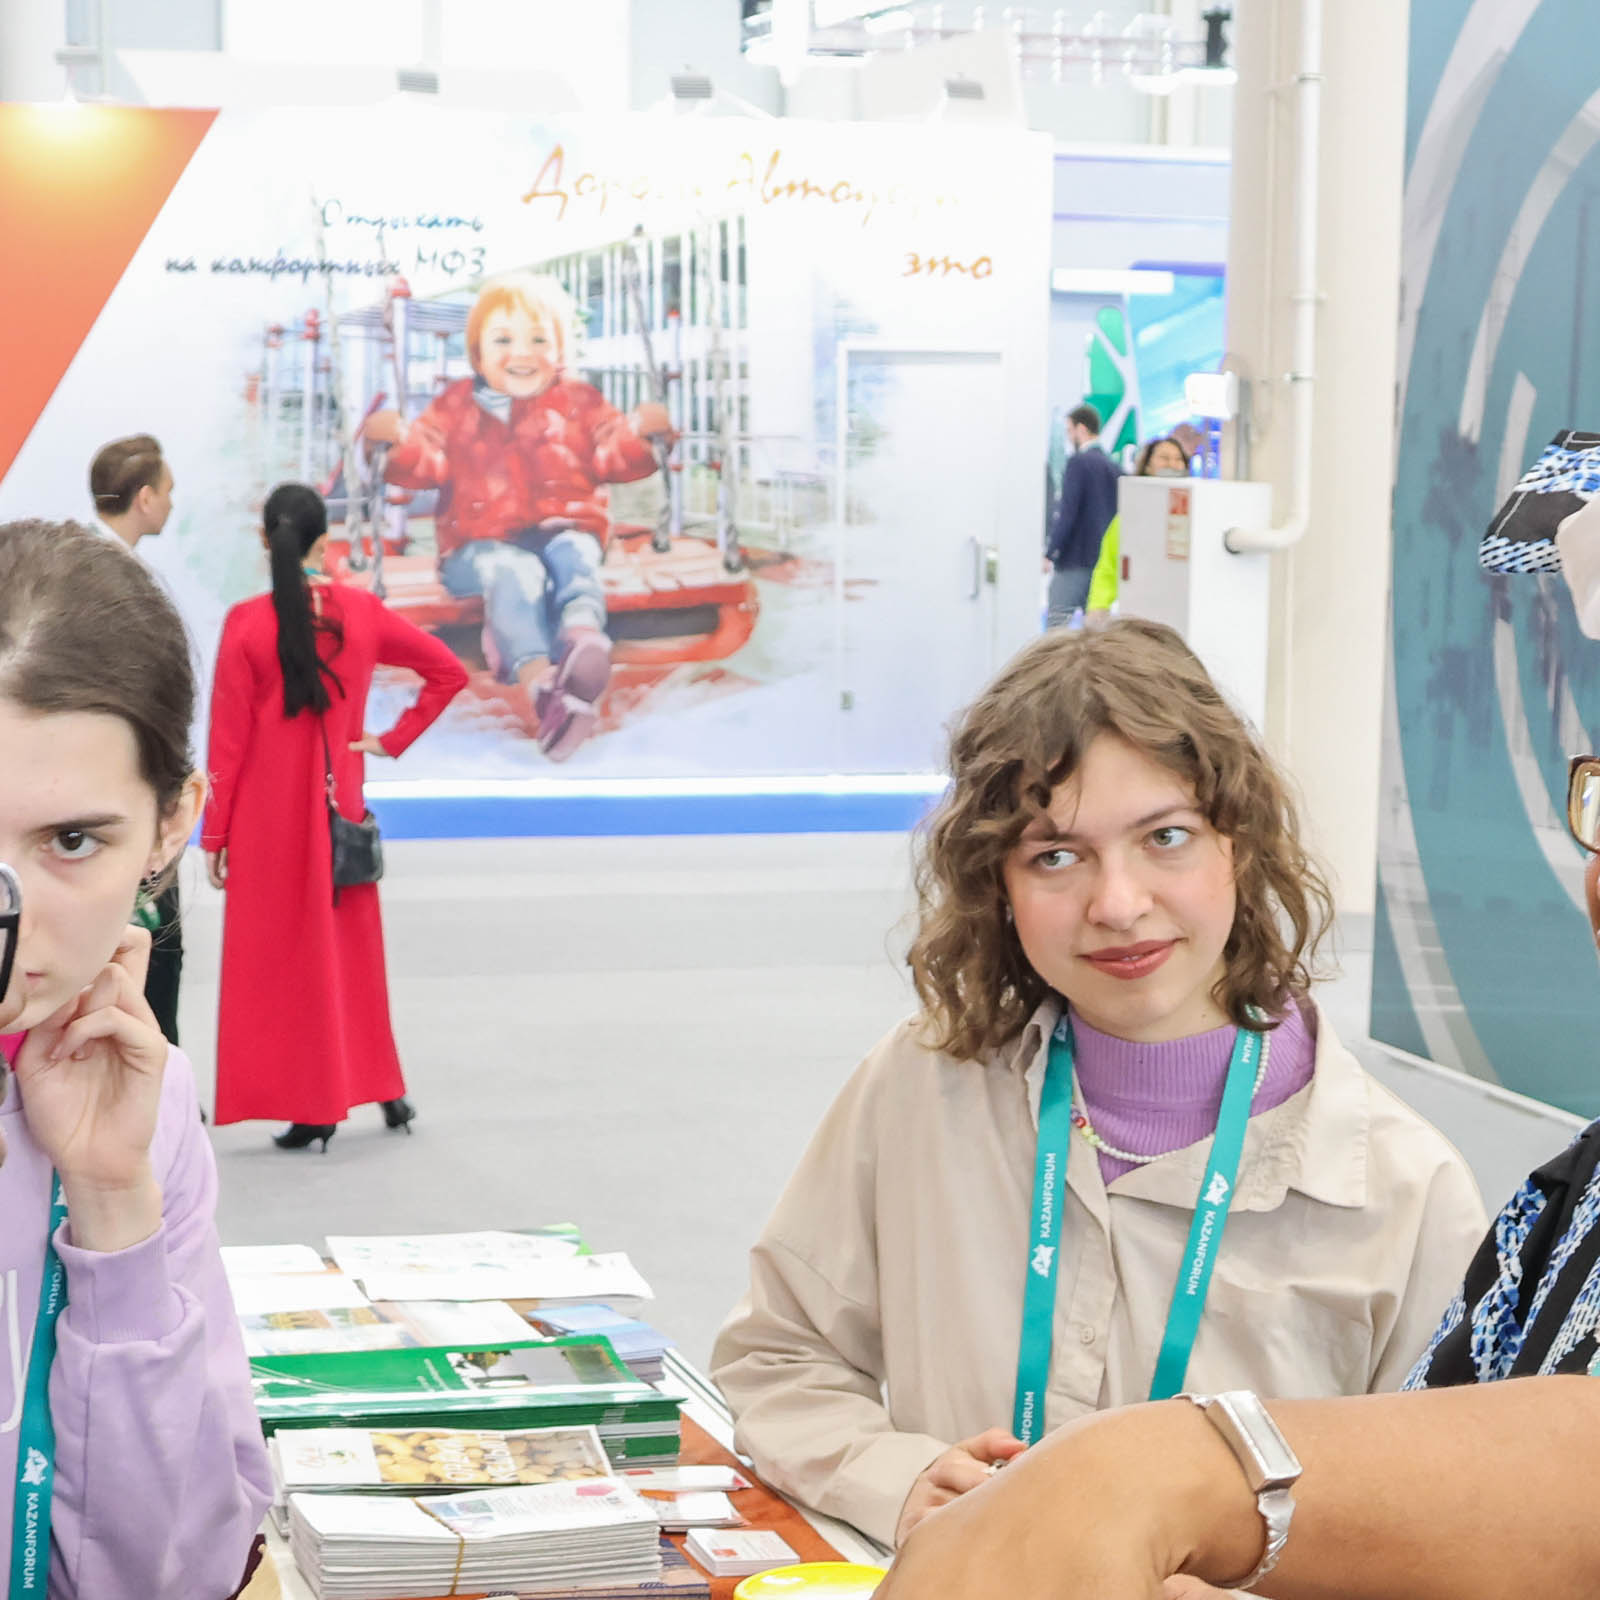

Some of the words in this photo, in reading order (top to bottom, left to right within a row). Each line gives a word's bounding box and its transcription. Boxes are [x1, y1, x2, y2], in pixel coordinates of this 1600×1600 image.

[164, 256, 198, 273] на
[901, 252, 994, 280] это
[1040, 1152, 1057, 1239] KAZANFORUM
[1185, 1209, 1217, 1296] KAZANFORUM
[21, 1492, 41, 1590] KAZANFORUM
